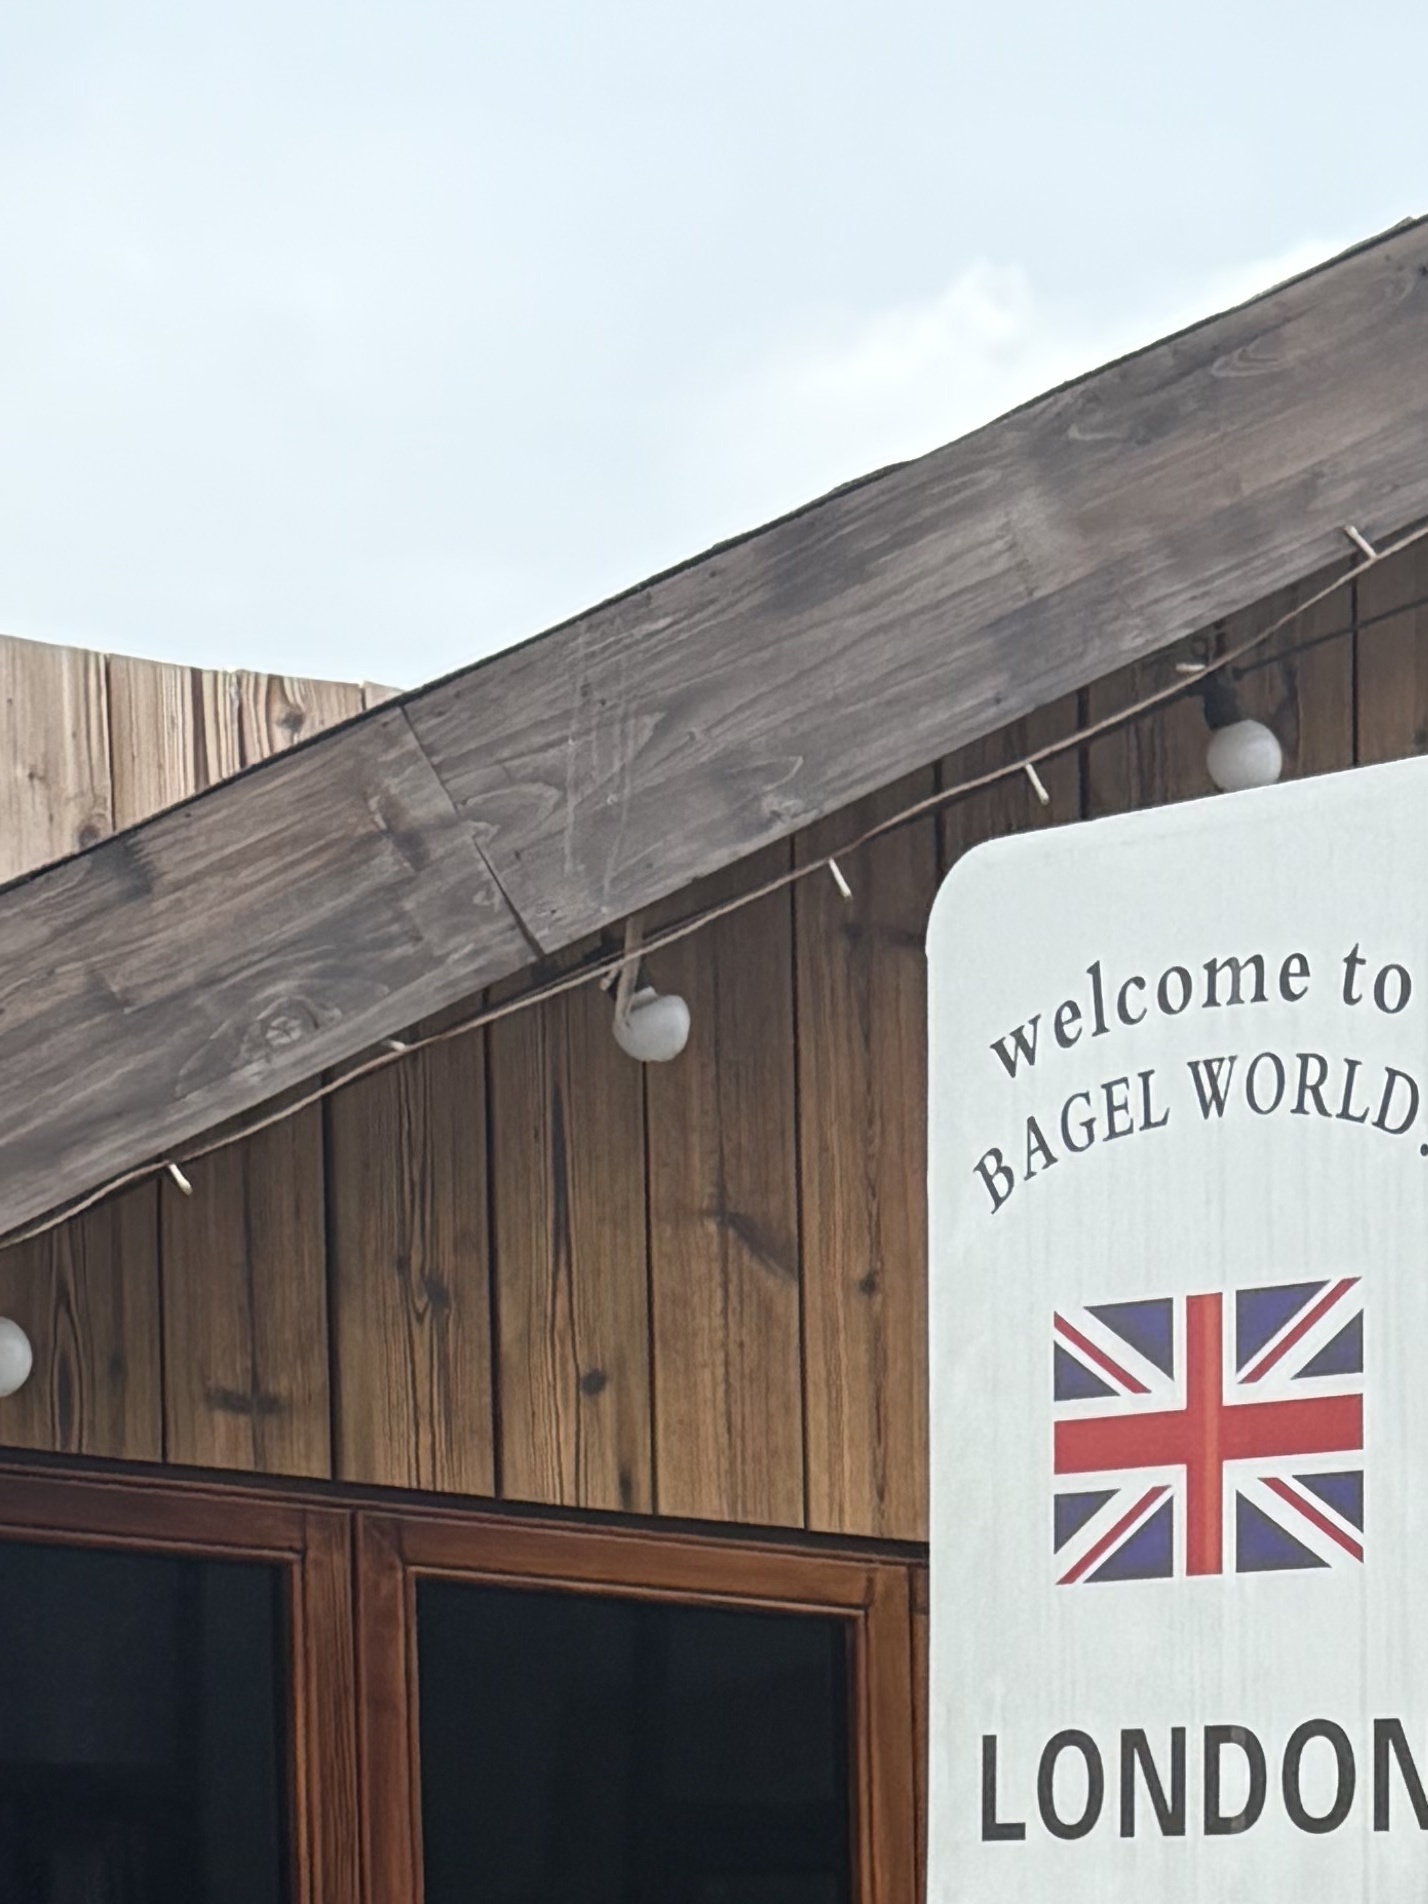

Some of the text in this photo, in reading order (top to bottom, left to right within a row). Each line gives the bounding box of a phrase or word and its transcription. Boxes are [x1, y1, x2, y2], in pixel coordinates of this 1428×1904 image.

[990, 943, 1412, 1079] welcome to
[974, 1069, 1170, 1214] BAGEL
